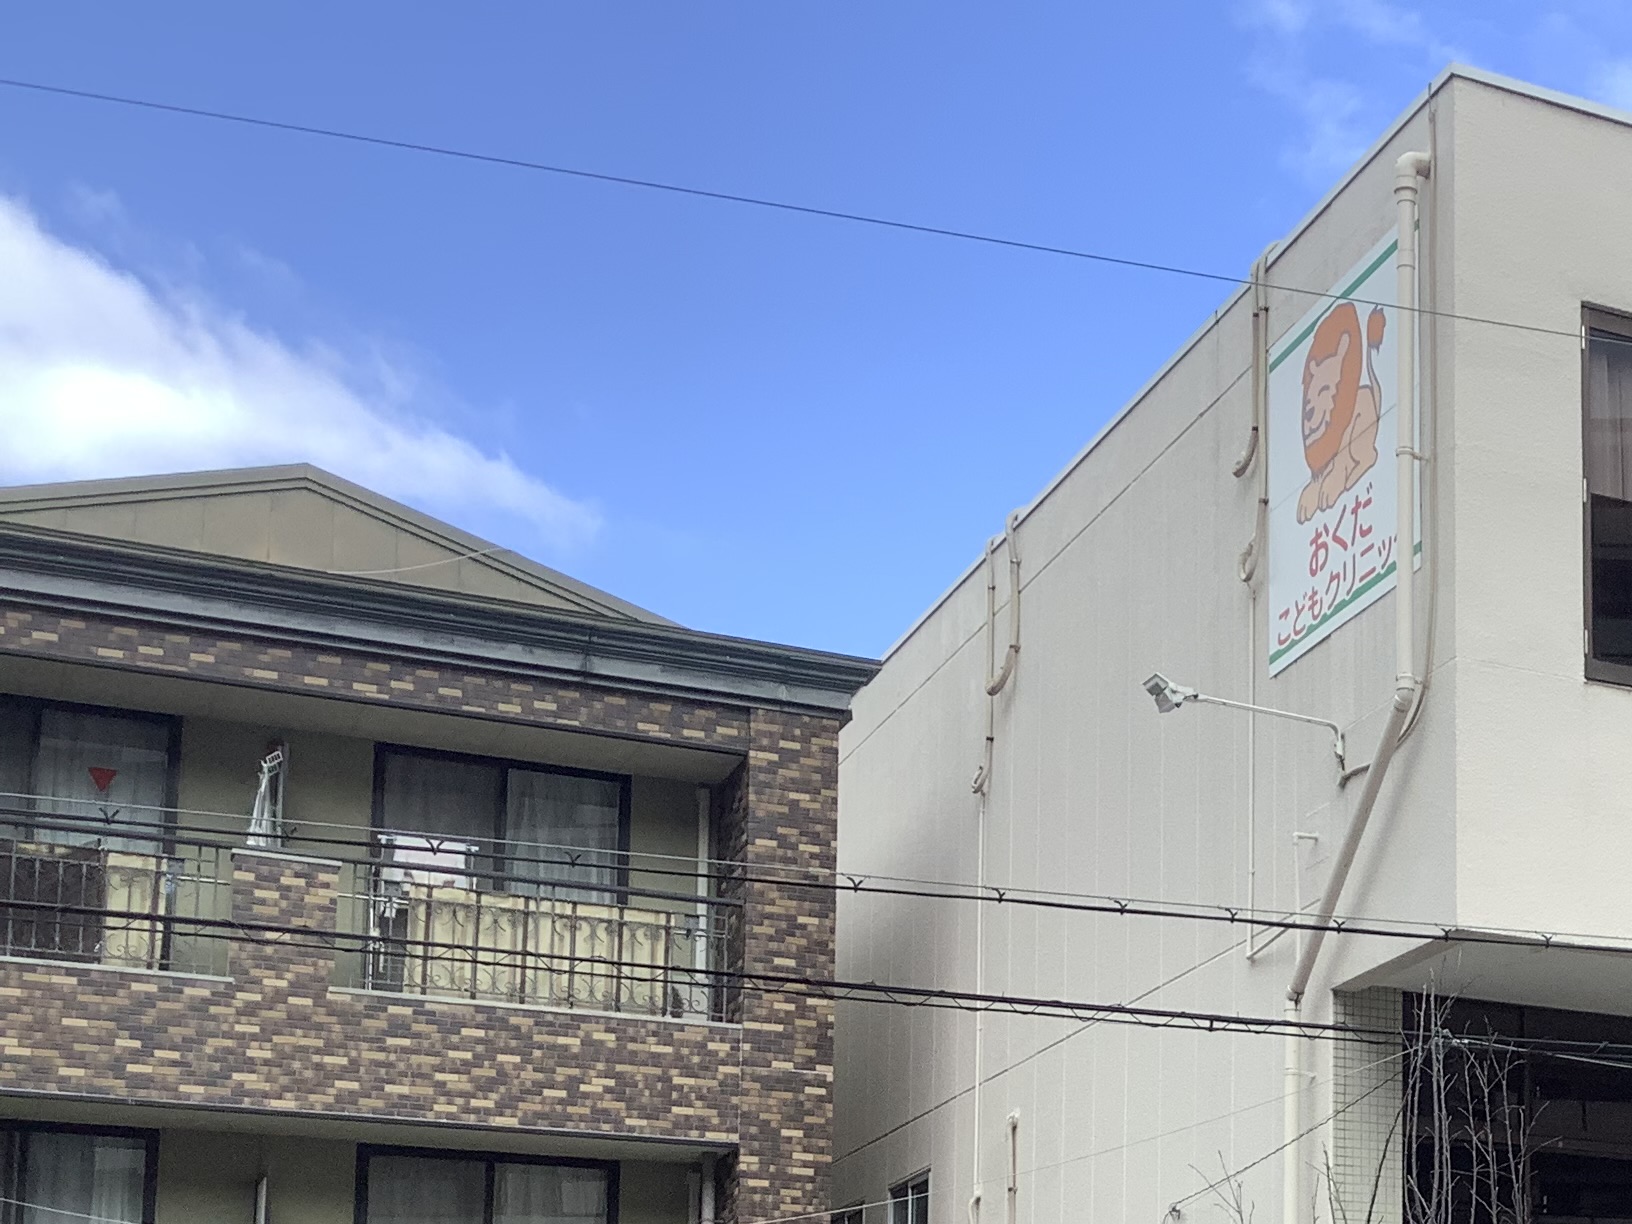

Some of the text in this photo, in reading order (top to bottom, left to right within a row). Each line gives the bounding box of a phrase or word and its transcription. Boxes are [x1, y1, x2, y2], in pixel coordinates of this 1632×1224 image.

[1310, 482, 1373, 577] おくだ
[1278, 535, 1397, 646] こどもクリニッ
